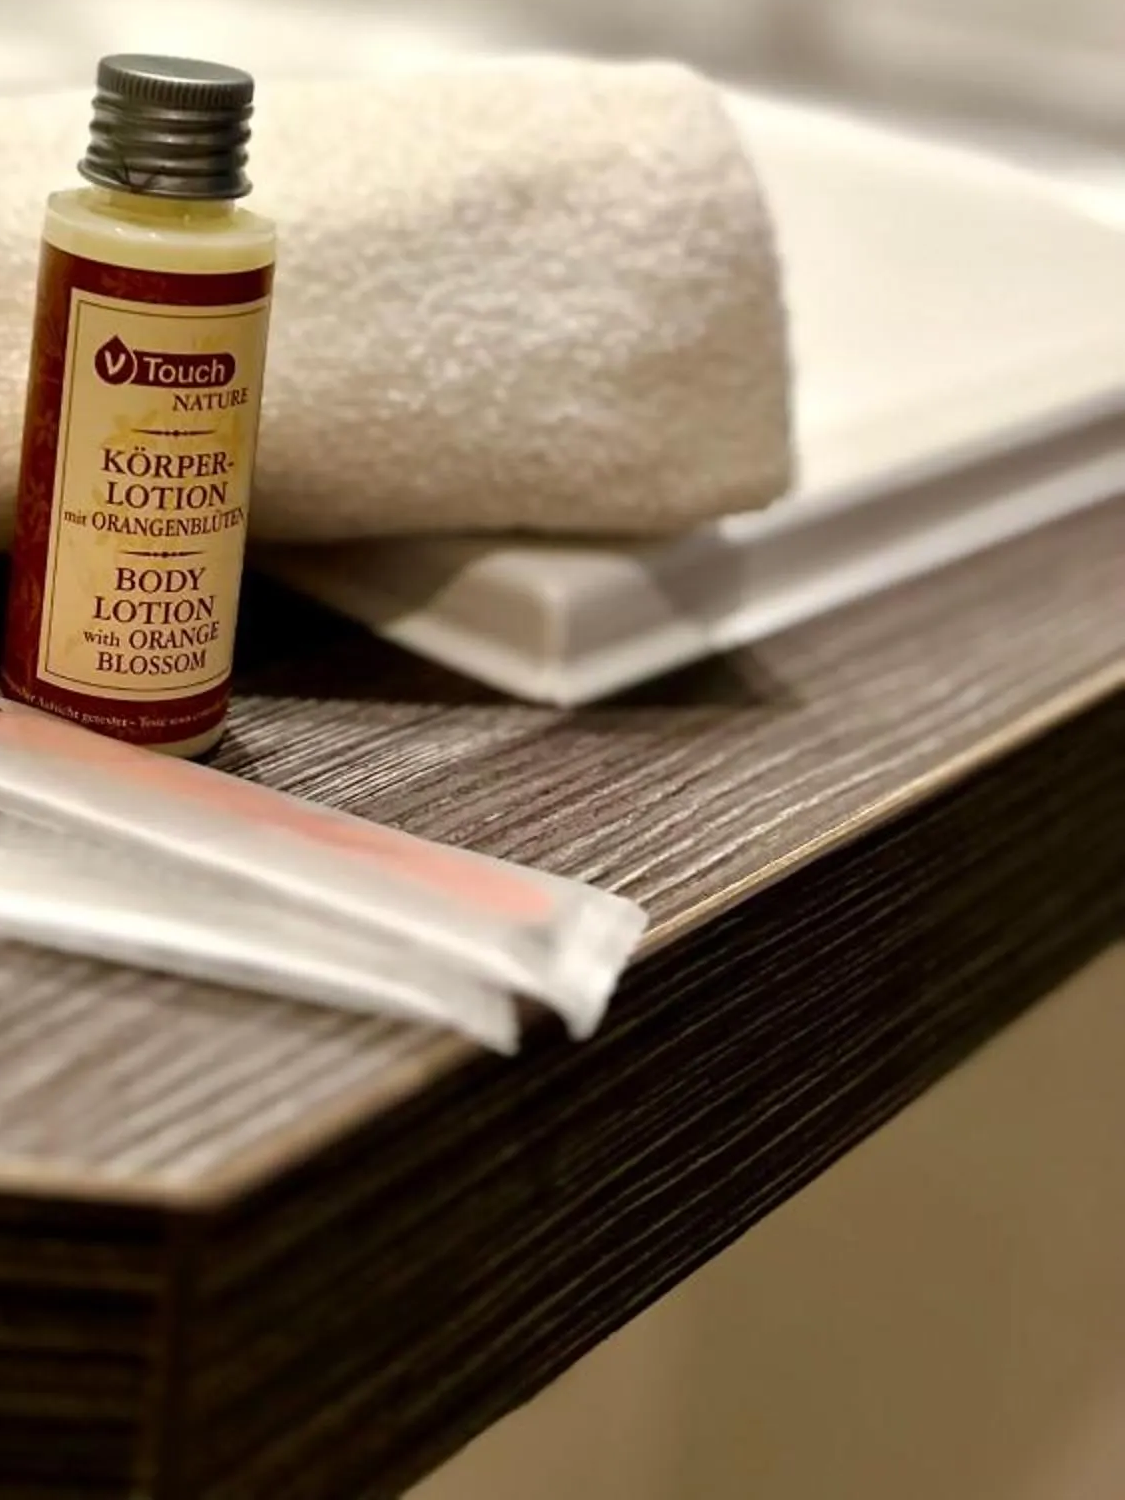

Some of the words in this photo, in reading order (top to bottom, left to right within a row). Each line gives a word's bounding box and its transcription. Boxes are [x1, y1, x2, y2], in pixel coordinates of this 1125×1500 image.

[143, 356, 226, 384] Touch
[172, 388, 249, 412] NATURE
[101, 447, 235, 479] KÖRPER-
[106, 481, 228, 510] LOTION
[63, 510, 87, 526] mit
[92, 507, 244, 537] ORANGENBLÜTEN
[114, 567, 207, 593] BODY
[93, 595, 216, 625] LOTION
[83, 629, 120, 648] with
[128, 621, 220, 650] ORANGE
[95, 650, 207, 676] BLOSSOM
